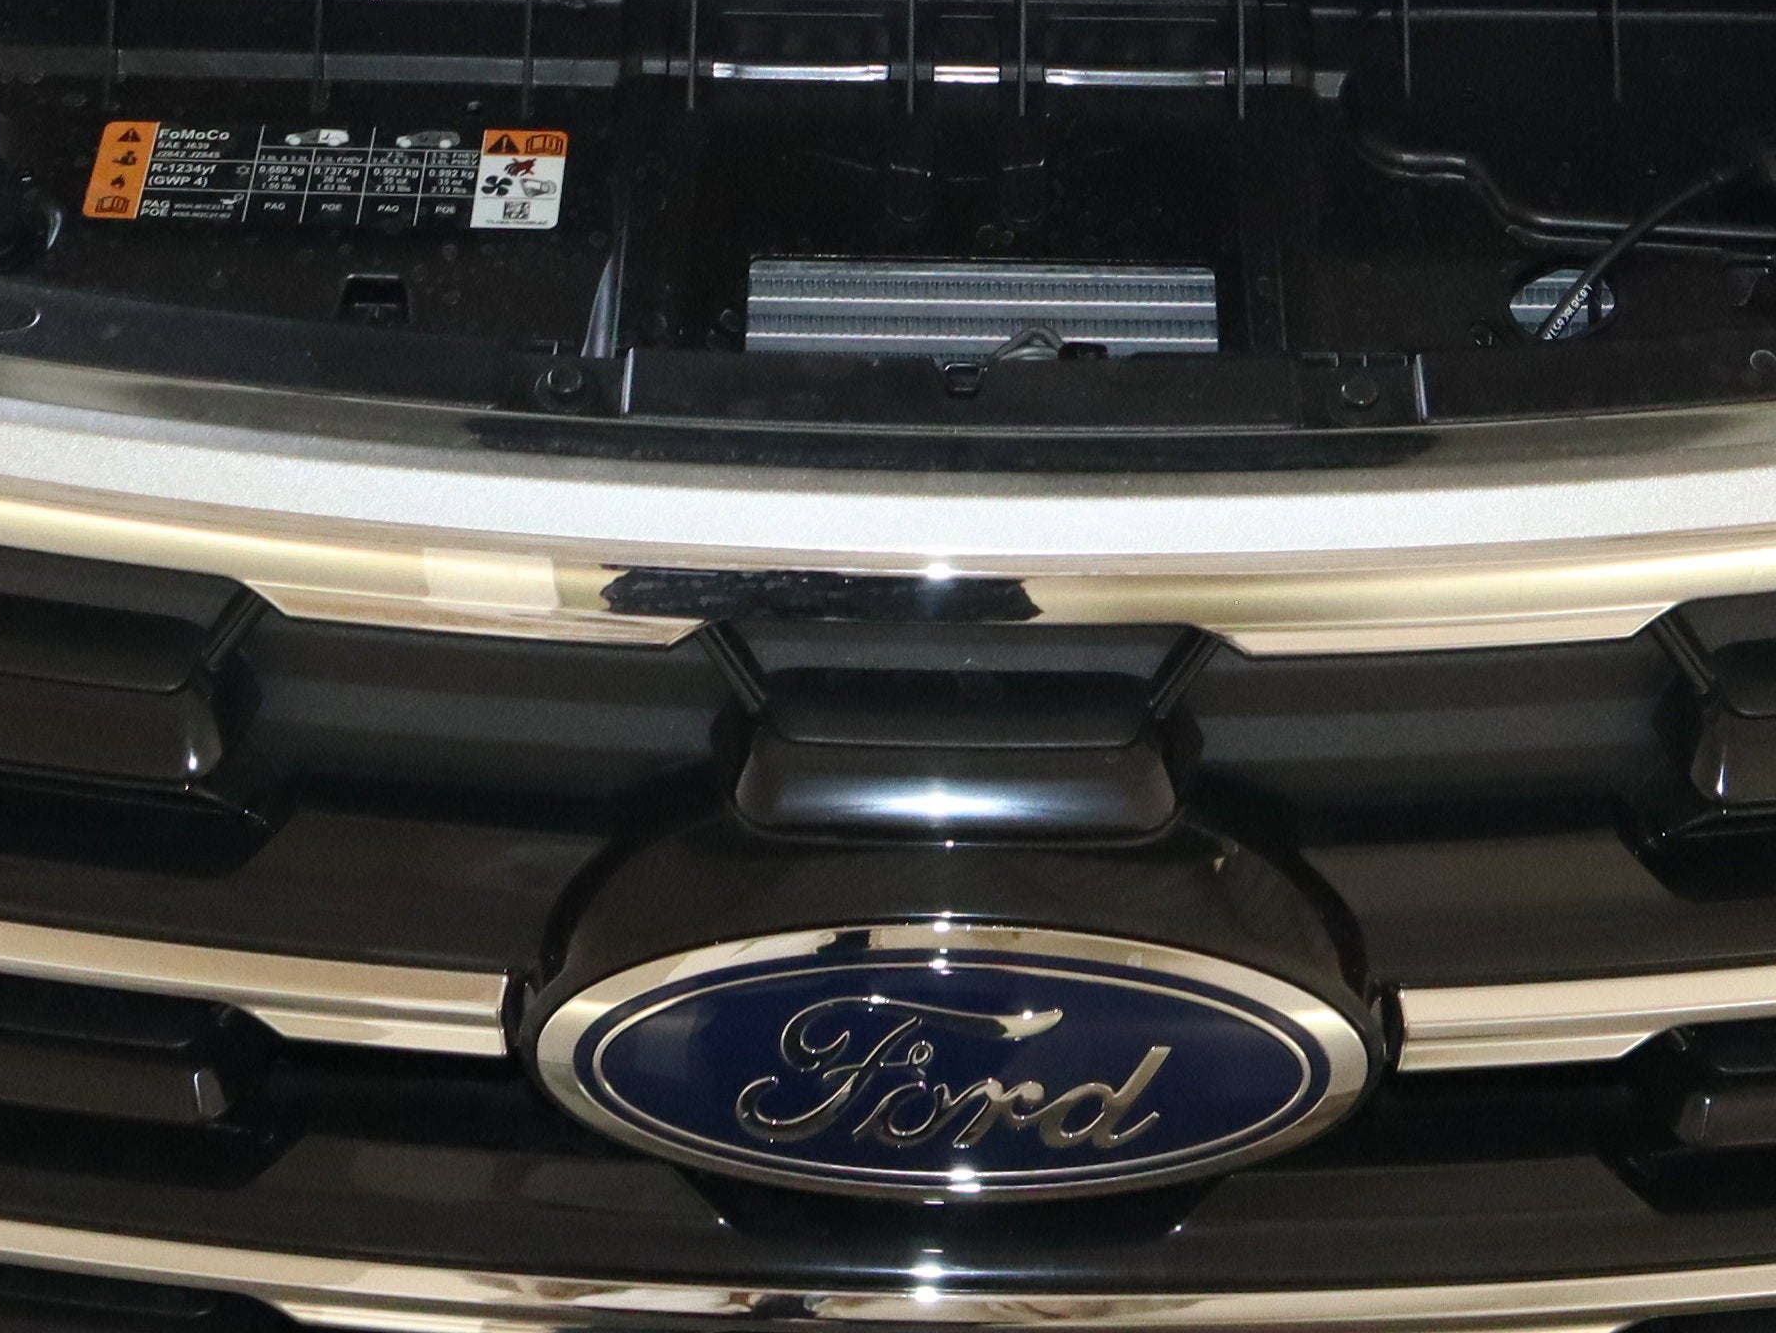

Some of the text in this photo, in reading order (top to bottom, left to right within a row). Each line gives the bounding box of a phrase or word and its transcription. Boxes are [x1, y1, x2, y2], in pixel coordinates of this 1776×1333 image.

[158, 128, 230, 141] FoMoCo
[151, 163, 218, 175] R-1234yf
[291, 166, 305, 176] kg
[346, 167, 360, 178] kg
[405, 169, 419, 178] kg
[461, 170, 475, 180] kg
[148, 175, 208, 188] (GWP 4)
[142, 199, 170, 208] PAG
[264, 202, 286, 210] PAG
[321, 203, 343, 211] POE
[139, 208, 169, 217] POE
[735, 995, 1172, 1149] Ford
